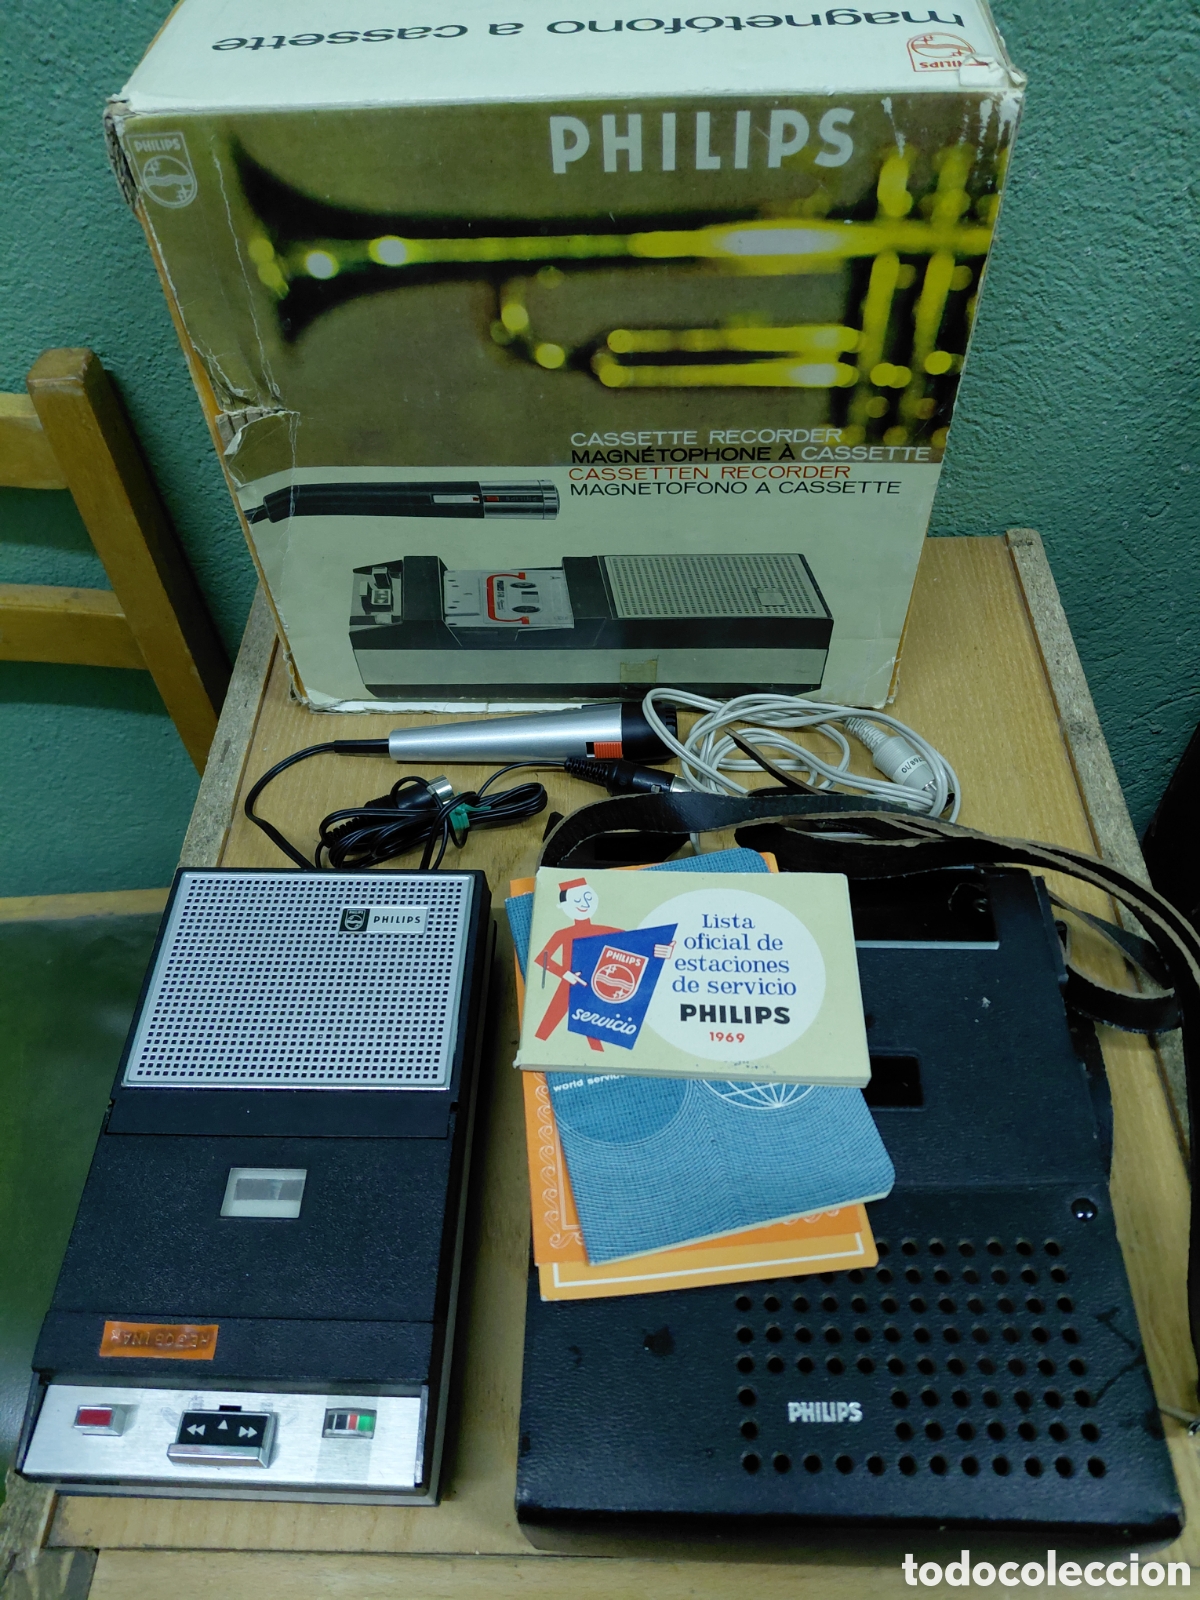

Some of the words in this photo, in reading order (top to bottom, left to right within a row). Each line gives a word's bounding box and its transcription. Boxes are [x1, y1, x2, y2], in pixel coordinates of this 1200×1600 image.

[489, 22, 524, 36] a
[547, 9, 965, 41] magnetófono
[211, 24, 468, 52] cassette
[134, 138, 181, 152] PHILIPS
[549, 108, 855, 174] PHILIPS
[570, 431, 698, 446] CASSETTE
[709, 428, 842, 444] RECORDER
[571, 446, 772, 463] MAGNÉTOPHONE
[778, 443, 796, 461] À
[801, 446, 931, 461] CASSETTE
[569, 466, 709, 480] CASSETTEN
[721, 465, 851, 479] RECORDER
[570, 481, 748, 495] MAGNETOFONO
[755, 481, 771, 494] A
[779, 481, 902, 494] CASSETTE
[373, 915, 421, 924] PHILIPS
[701, 913, 755, 929] Lista
[683, 933, 751, 950] oficial
[757, 933, 784, 951] de
[606, 949, 642, 967] PHILIPS
[674, 954, 790, 973] estaciones
[672, 975, 700, 993] de
[707, 977, 797, 996] servicio
[571, 1008, 637, 1035] servicio
[680, 1003, 791, 1025] PHILIPS
[709, 1031, 745, 1043] 1969
[552, 1078, 584, 1093] world
[787, 1401, 863, 1423] PHILIPS
